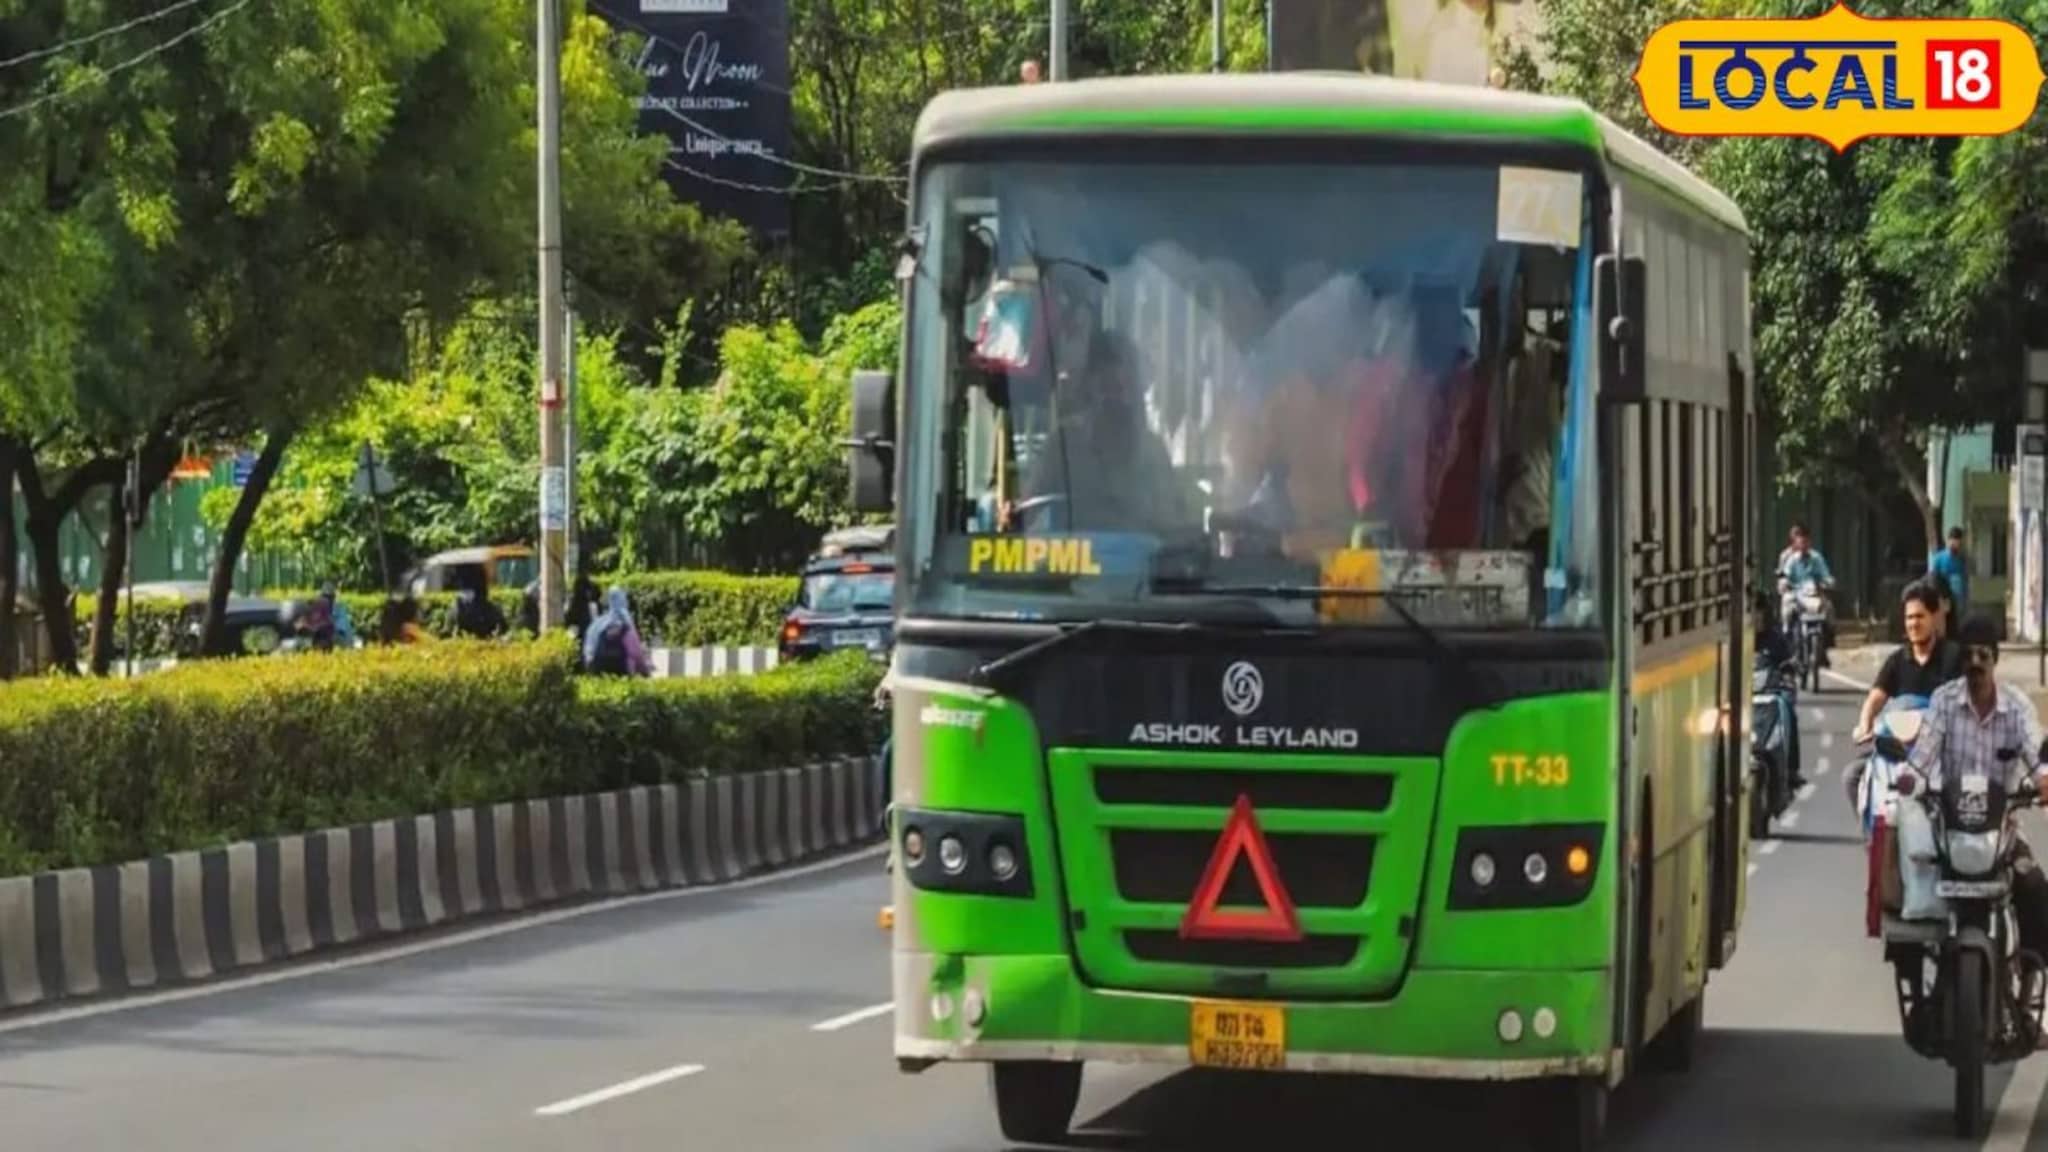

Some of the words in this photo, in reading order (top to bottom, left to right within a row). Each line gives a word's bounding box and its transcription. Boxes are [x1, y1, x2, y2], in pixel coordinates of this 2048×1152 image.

[682, 30, 763, 92] Moon
[969, 538, 1101, 574] PMPML
[1129, 723, 1221, 743] ASHOK
[1237, 726, 1358, 747] LEYLAND
[1490, 754, 1568, 786] TT-33
